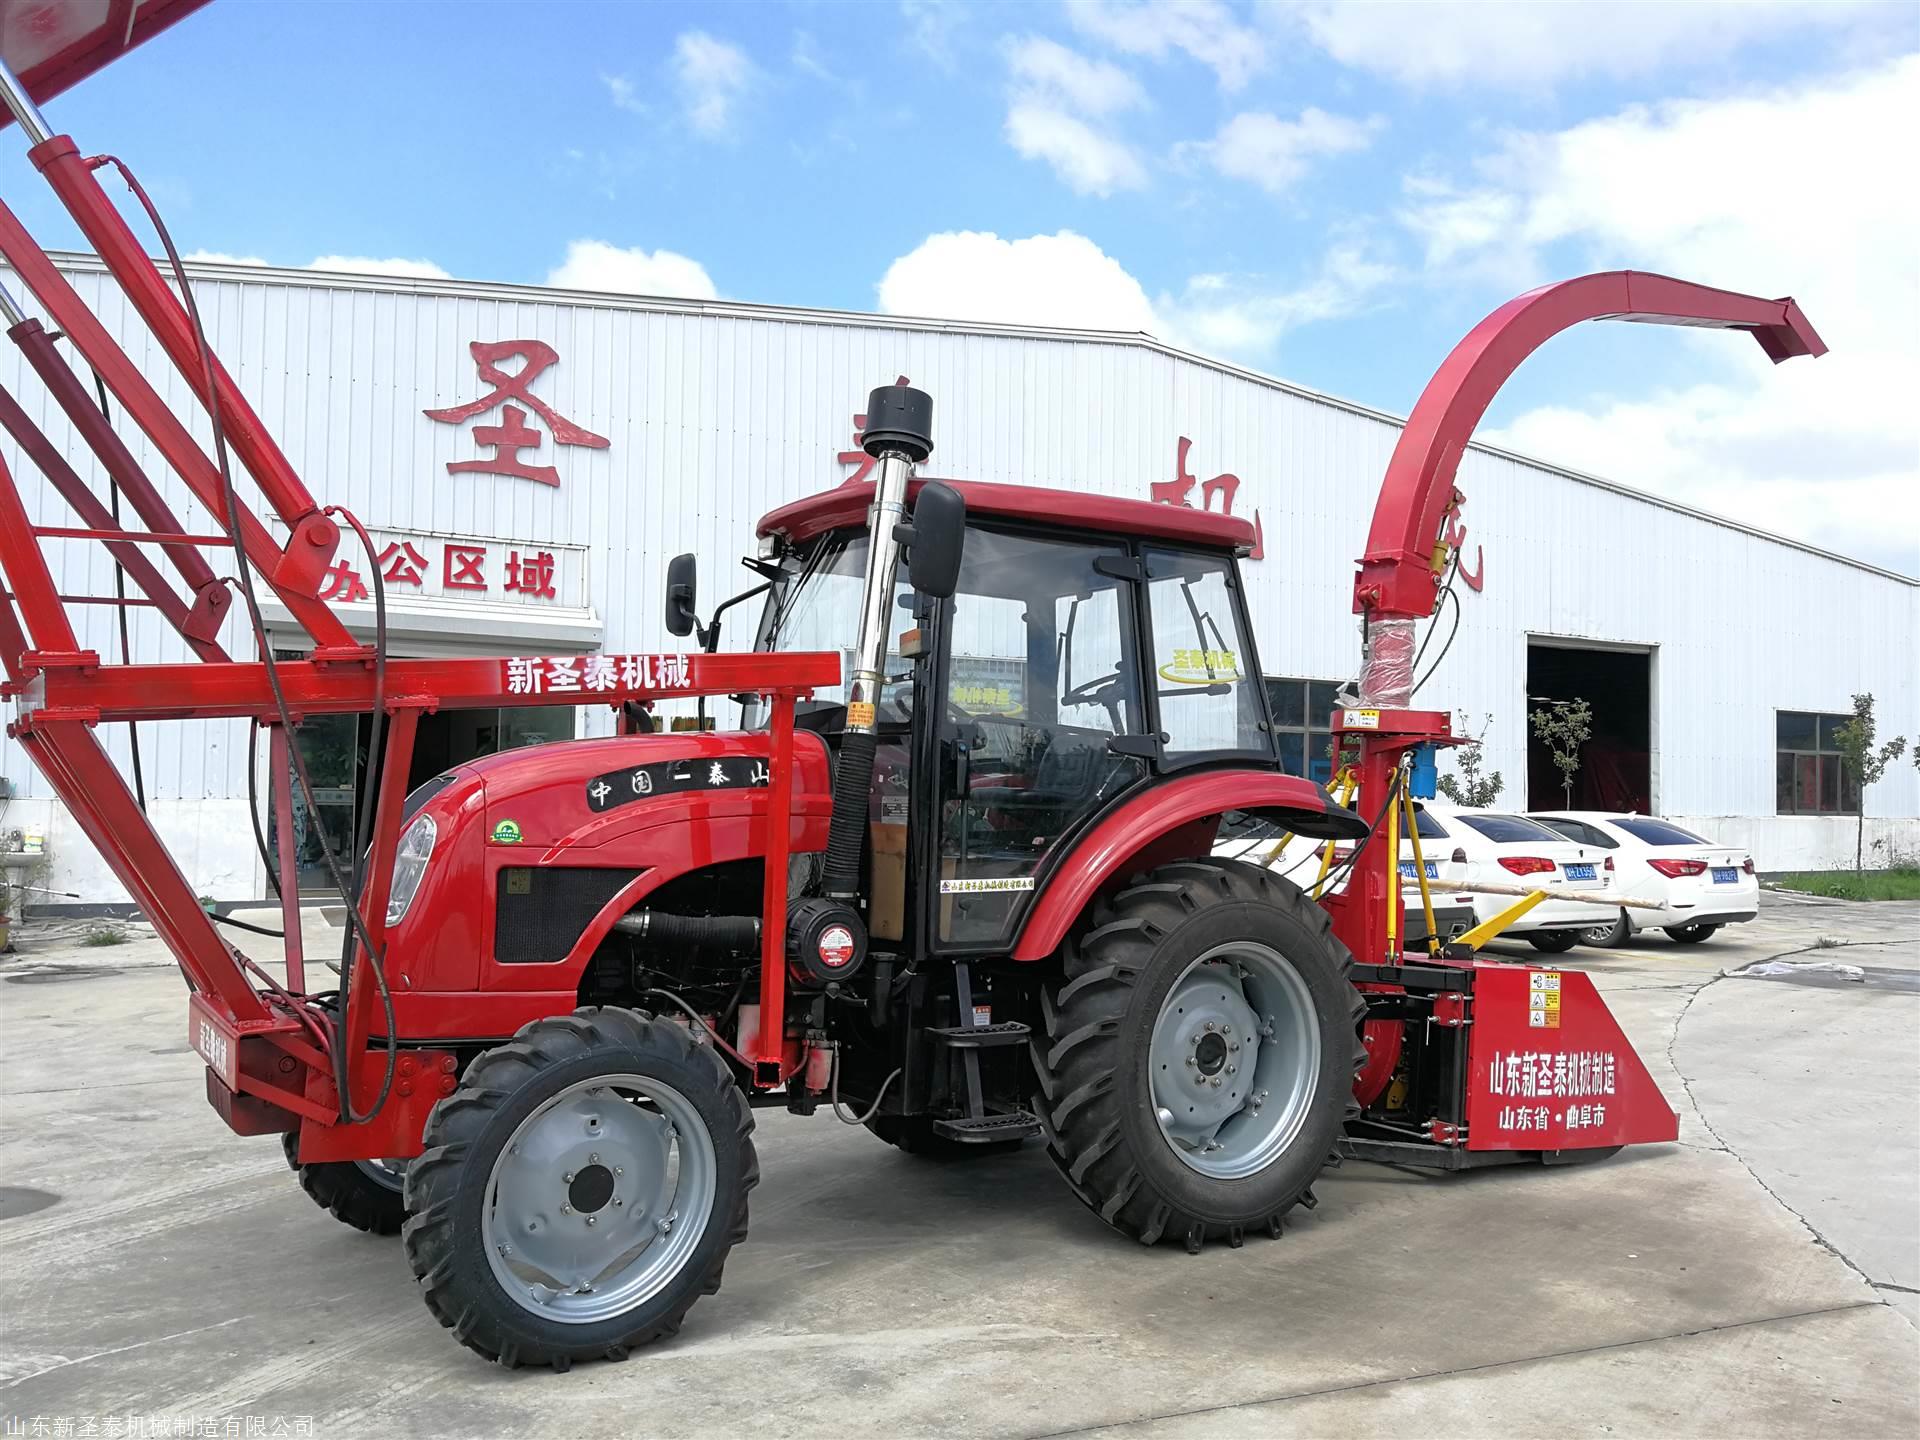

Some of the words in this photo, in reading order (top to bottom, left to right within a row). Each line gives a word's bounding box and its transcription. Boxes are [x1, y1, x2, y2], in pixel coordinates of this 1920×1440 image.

[319, 541, 556, 601] 办公区域
[507, 654, 691, 694] 新圣泰机械
[1489, 1051, 1615, 1097] 山东新圣泰机械制造
